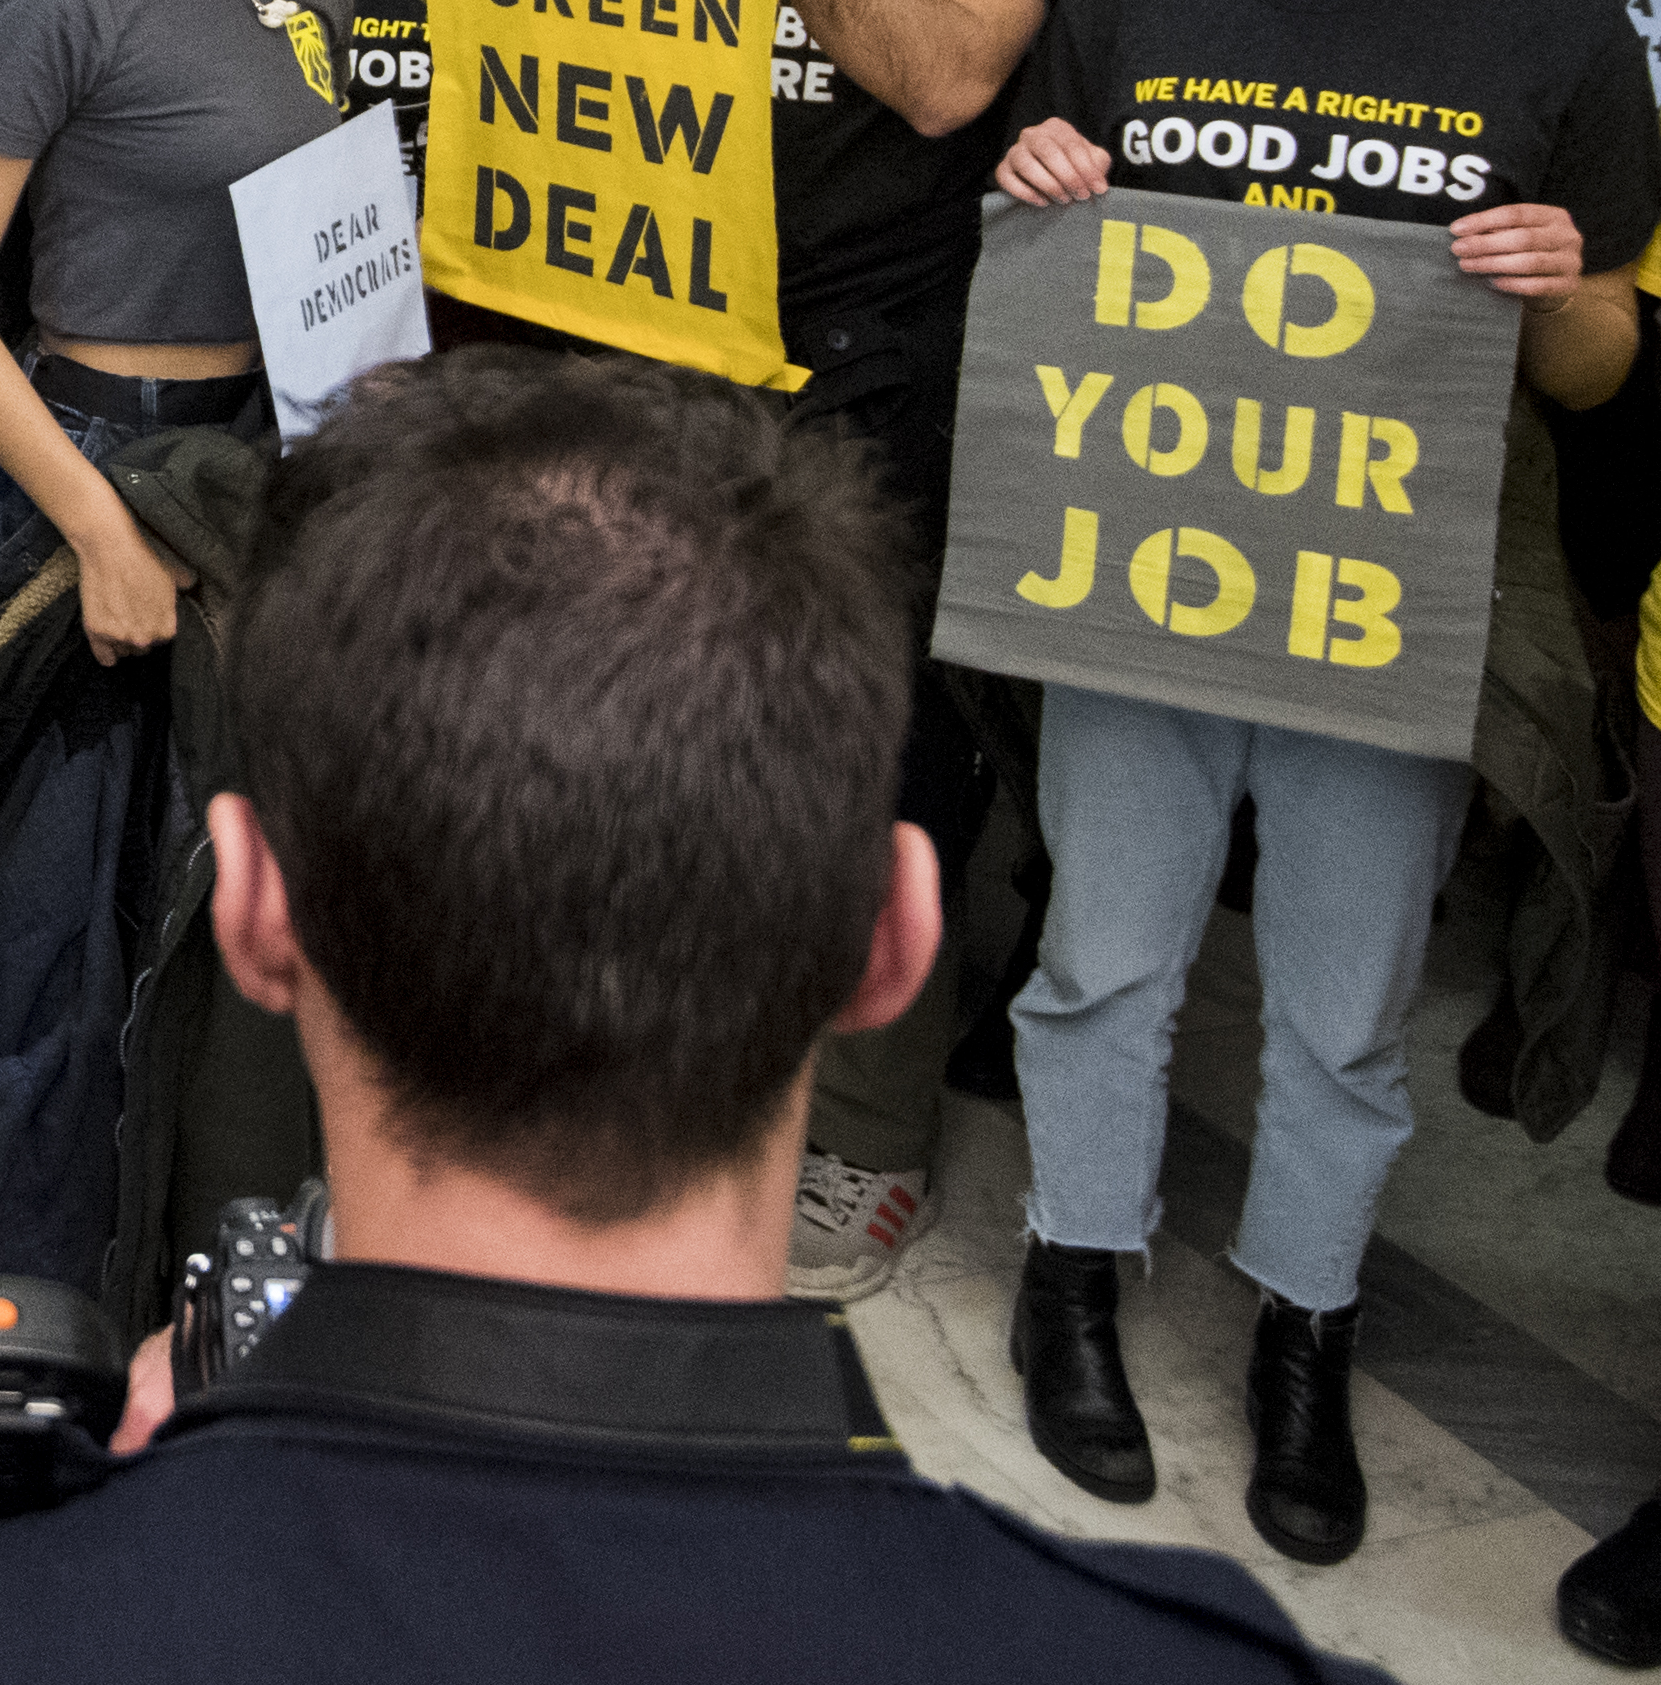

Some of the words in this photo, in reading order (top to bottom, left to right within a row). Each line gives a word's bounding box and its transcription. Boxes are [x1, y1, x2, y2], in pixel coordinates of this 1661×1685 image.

[478, 43, 736, 176] NEW
[1122, 116, 1298, 172] GOOD
[1311, 132, 1491, 201] JOBS
[1134, 75, 1178, 104] WE
[1182, 77, 1279, 110] HAVE
[1281, 86, 1309, 113] A
[1315, 88, 1434, 130] RIGHT
[1436, 105, 1484, 138] TO
[312, 200, 383, 265] DEAR
[473, 165, 729, 313] DEAL
[1242, 181, 1337, 215] AND
[299, 236, 414, 334] DEMOCRATS
[1094, 219, 1376, 359] DO
[1034, 364, 1422, 516] YOUR
[1015, 506, 1404, 669] JOB
